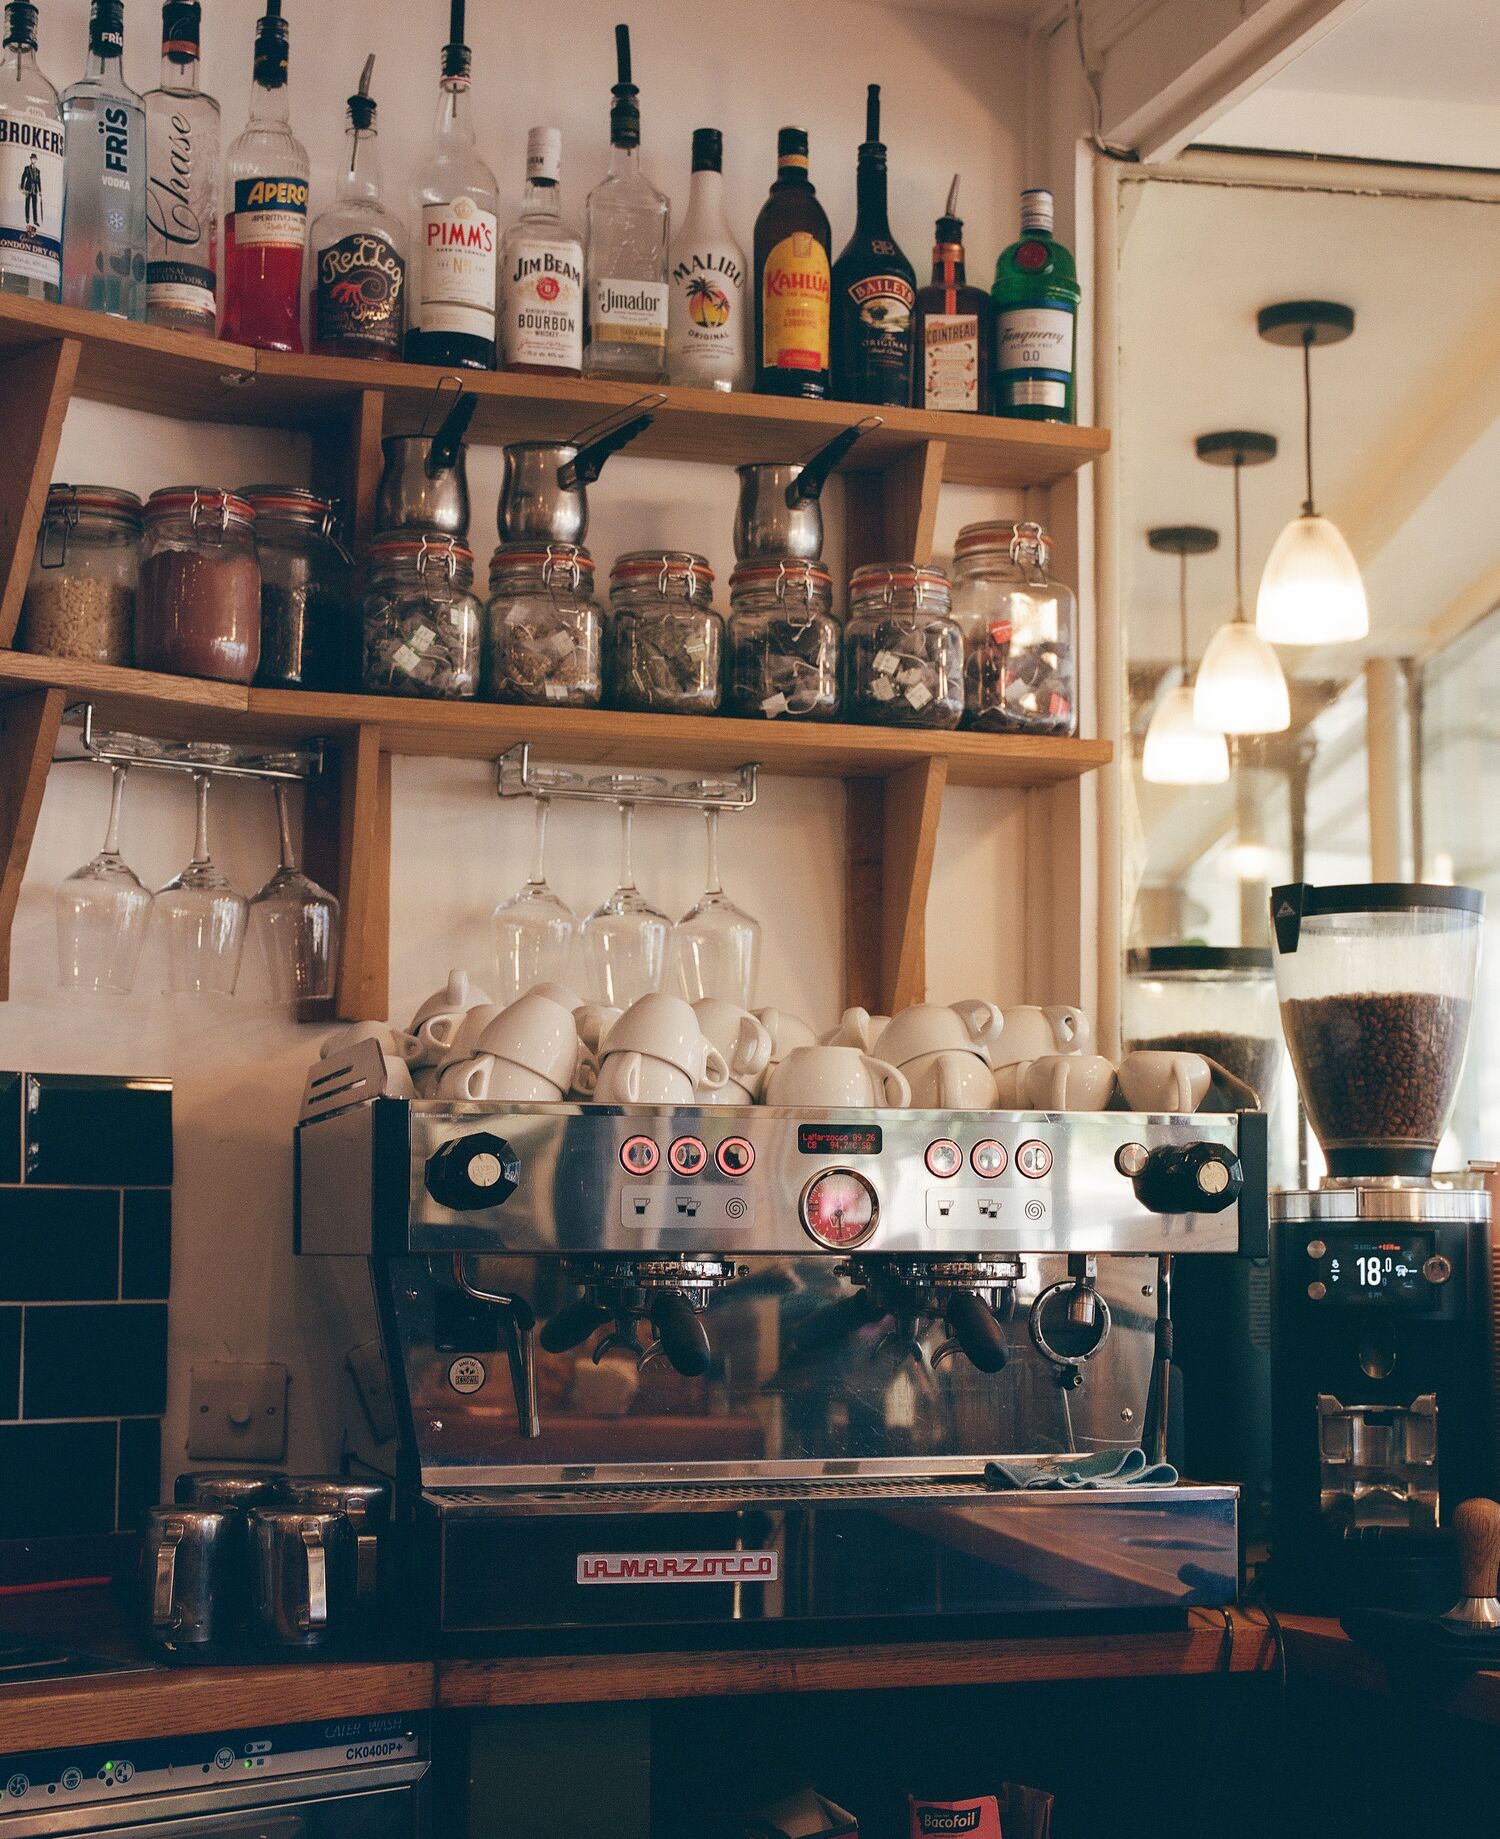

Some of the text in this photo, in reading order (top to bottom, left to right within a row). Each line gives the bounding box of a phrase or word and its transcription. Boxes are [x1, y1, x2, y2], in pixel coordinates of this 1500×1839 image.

[99, 107, 128, 173] FRÏS
[101, 175, 131, 191] VODKA
[146, 111, 200, 255] Chase
[0, 238, 31, 252] ONDON
[32, 245, 49, 256] DRY
[428, 222, 492, 252] PIMM'S
[513, 253, 580, 287] JIM BEAM
[673, 253, 744, 288] MALIBU
[601, 288, 661, 313] Jimador
[855, 279, 914, 304] BAILEYS
[518, 314, 574, 333] BOURBON
[926, 323, 977, 344] COINTREAU
[688, 329, 730, 340] ORIGINAL
[1001, 327, 1064, 345] Tanqueray
[862, 339, 908, 352] ORIGINAL
[1022, 350, 1040, 362] 0.0
[1356, 1257, 1392, 1286] 18.0
[584, 1557, 772, 1578] LA MARZOCCO
[346, 1742, 402, 1760] CK0400P+
[924, 1811, 976, 1828] Bacofoil
